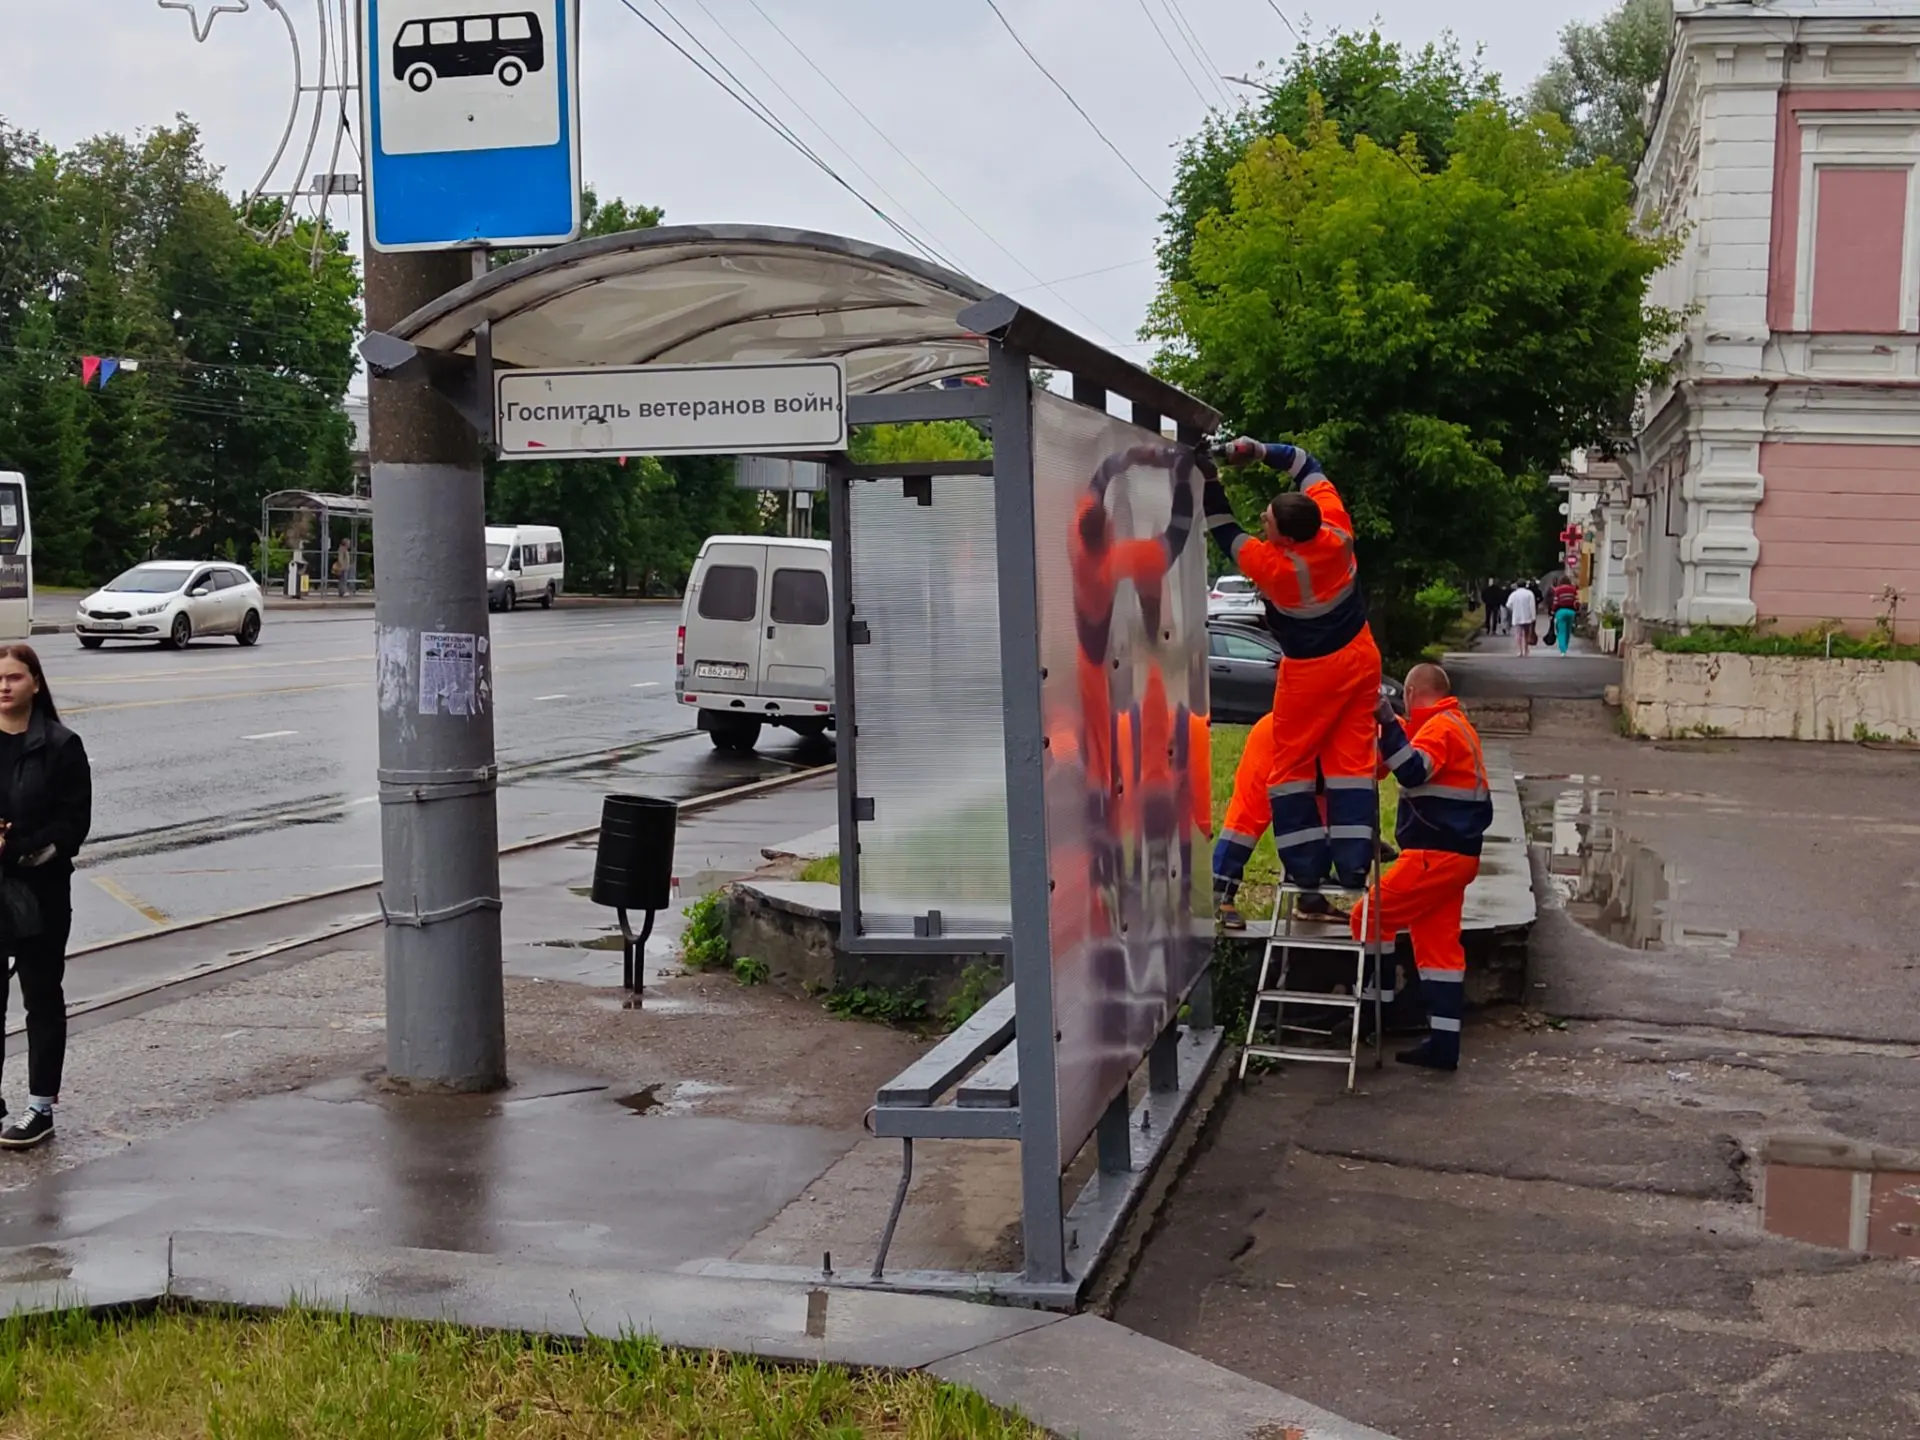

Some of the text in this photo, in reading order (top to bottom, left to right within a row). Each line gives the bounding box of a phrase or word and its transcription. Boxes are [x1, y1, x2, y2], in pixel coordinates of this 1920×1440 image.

[507, 392, 833, 421] Госпиталь ветеранов войн
